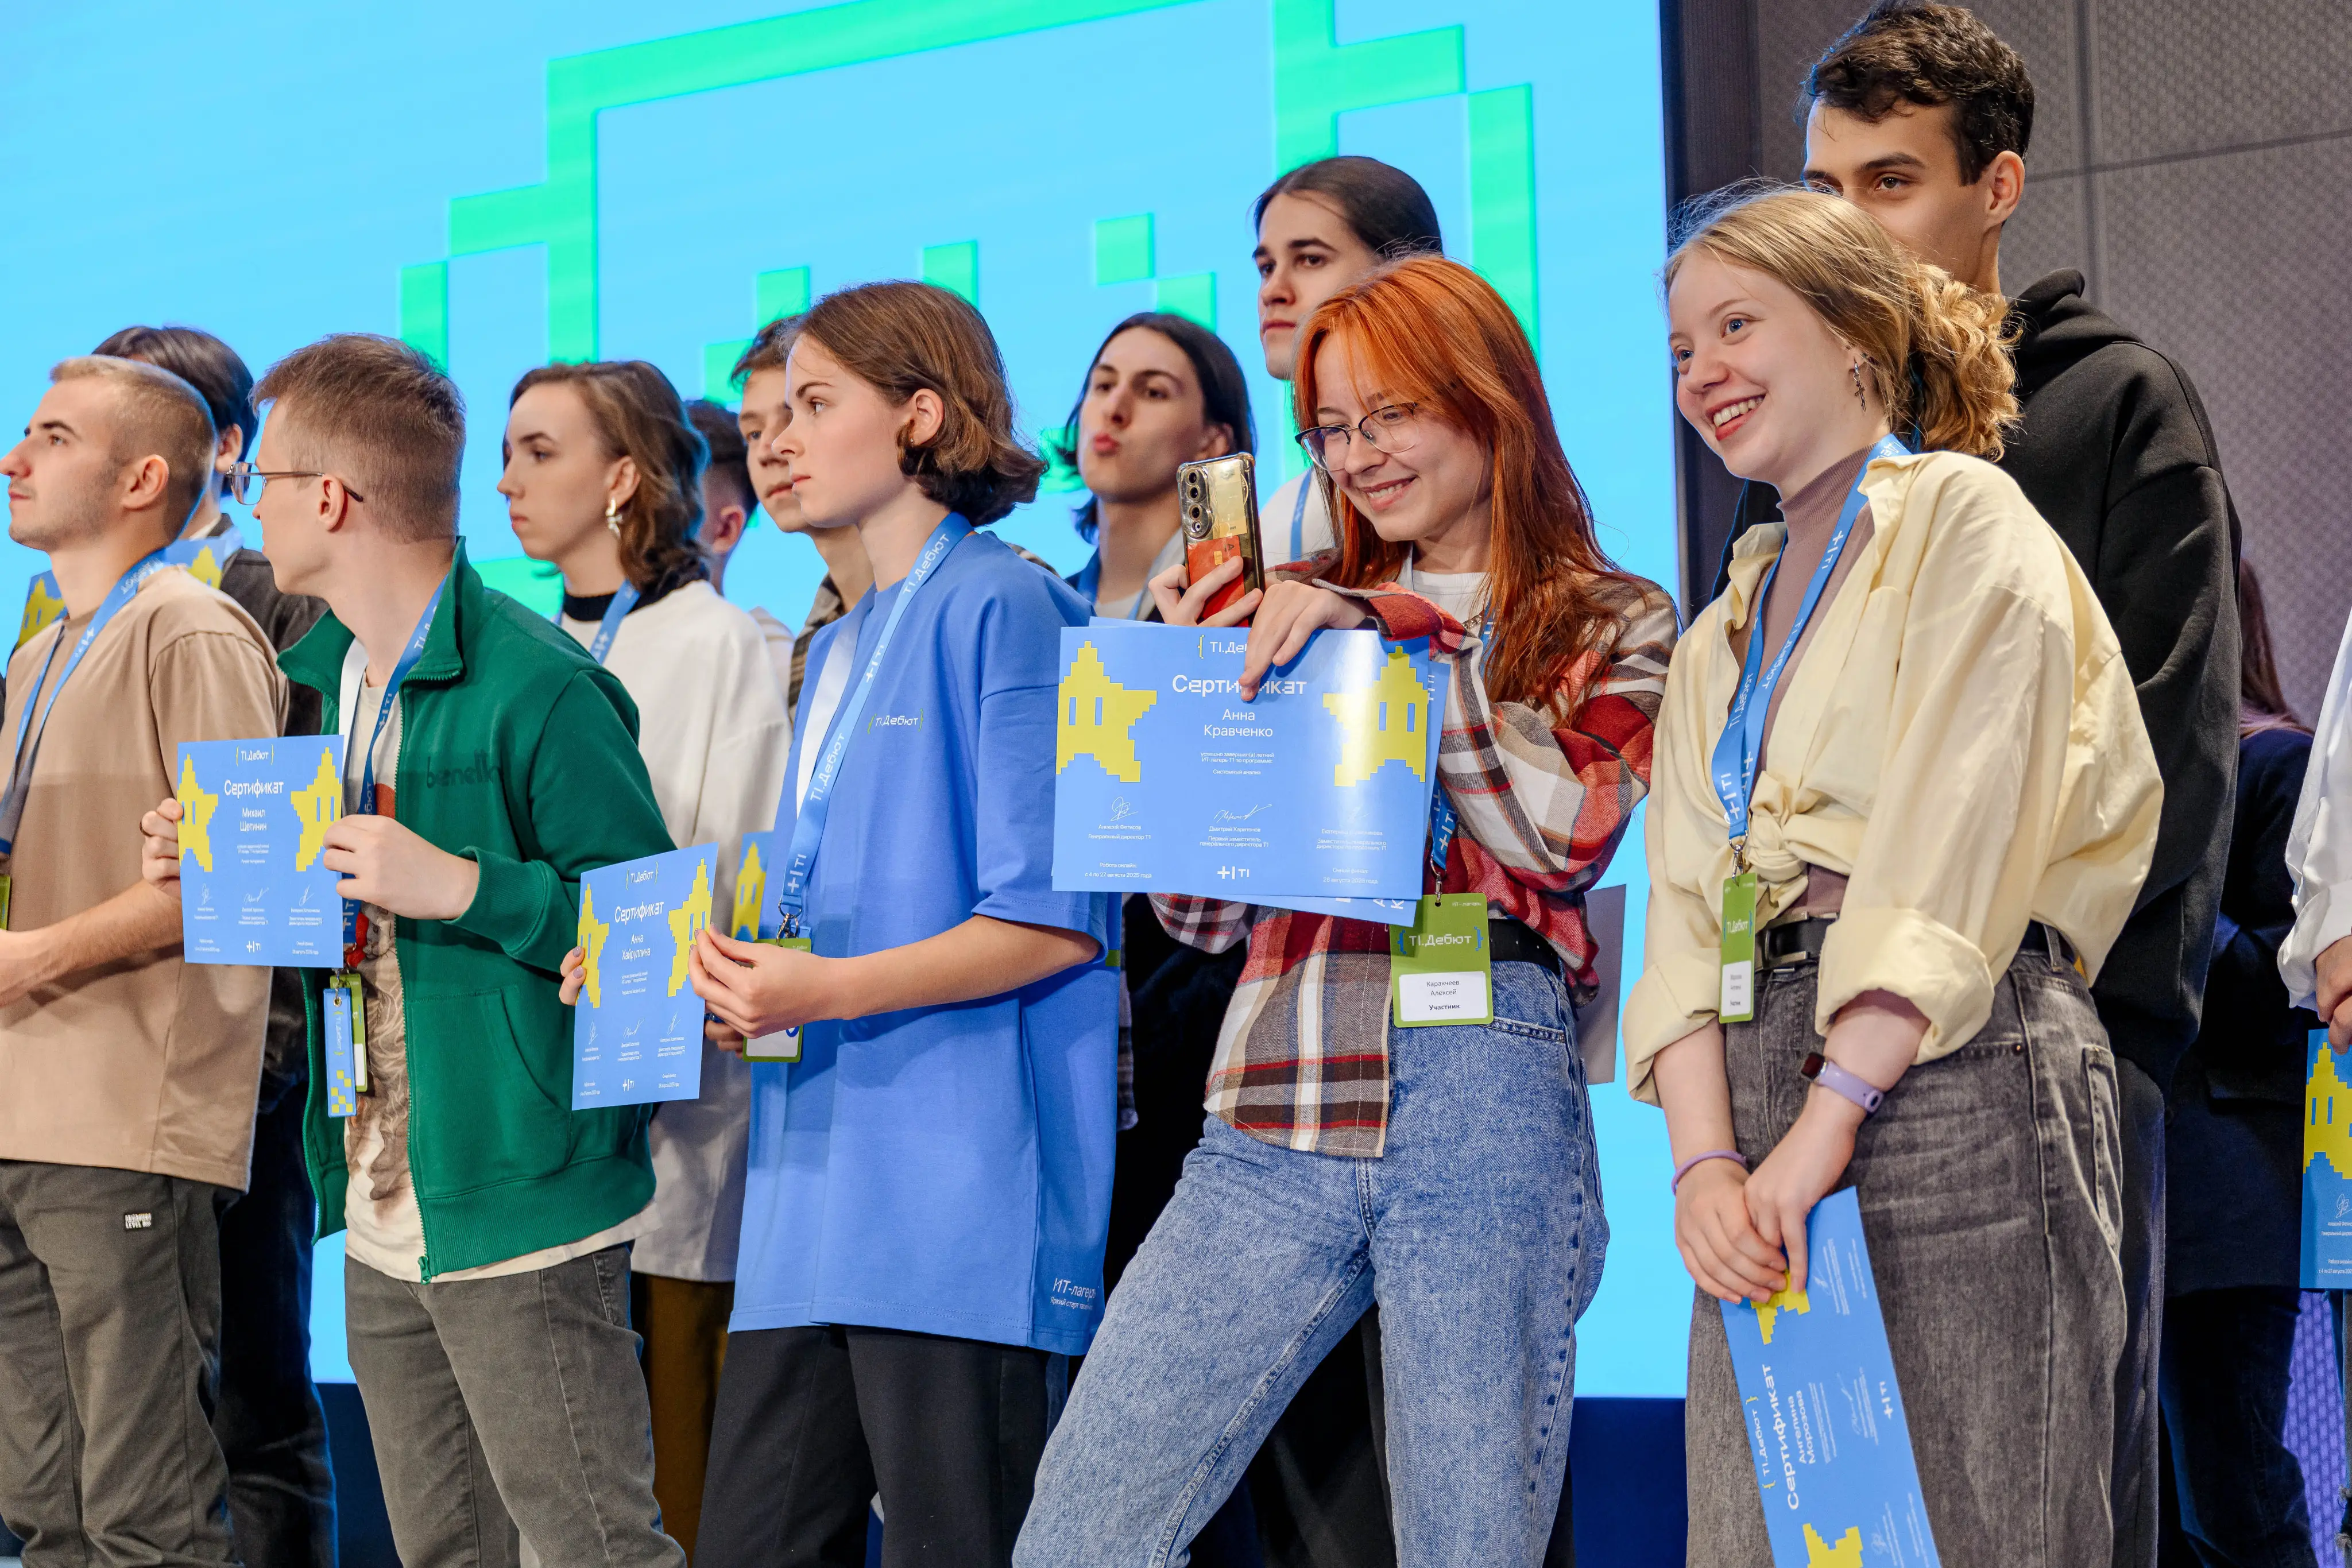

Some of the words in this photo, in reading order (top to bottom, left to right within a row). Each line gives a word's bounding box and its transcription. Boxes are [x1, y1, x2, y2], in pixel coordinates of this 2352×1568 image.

[1172, 674, 1307, 698] Сертиикат
[1222, 708, 1255, 721] Анна
[1204, 725, 1273, 738] Кравченко
[224, 779, 284, 799] Сертификат
[242, 807, 265, 818] Михаил
[240, 820, 267, 833] Щетинин
[614, 901, 664, 925] Сертификат
[631, 934, 644, 944] Анна
[622, 947, 651, 961] Хайруллина
[1430, 988, 1457, 996] Алексей
[1053, 1277, 1096, 1302] ИТ-лагерь
[1050, 1296, 1066, 1306] Яркий
[1066, 1300, 1079, 1310] старт
[1788, 1395, 1807, 1465] Ангелина
[1796, 1390, 1816, 1465] Морозова
[1762, 1364, 1799, 1510] Сертификат
